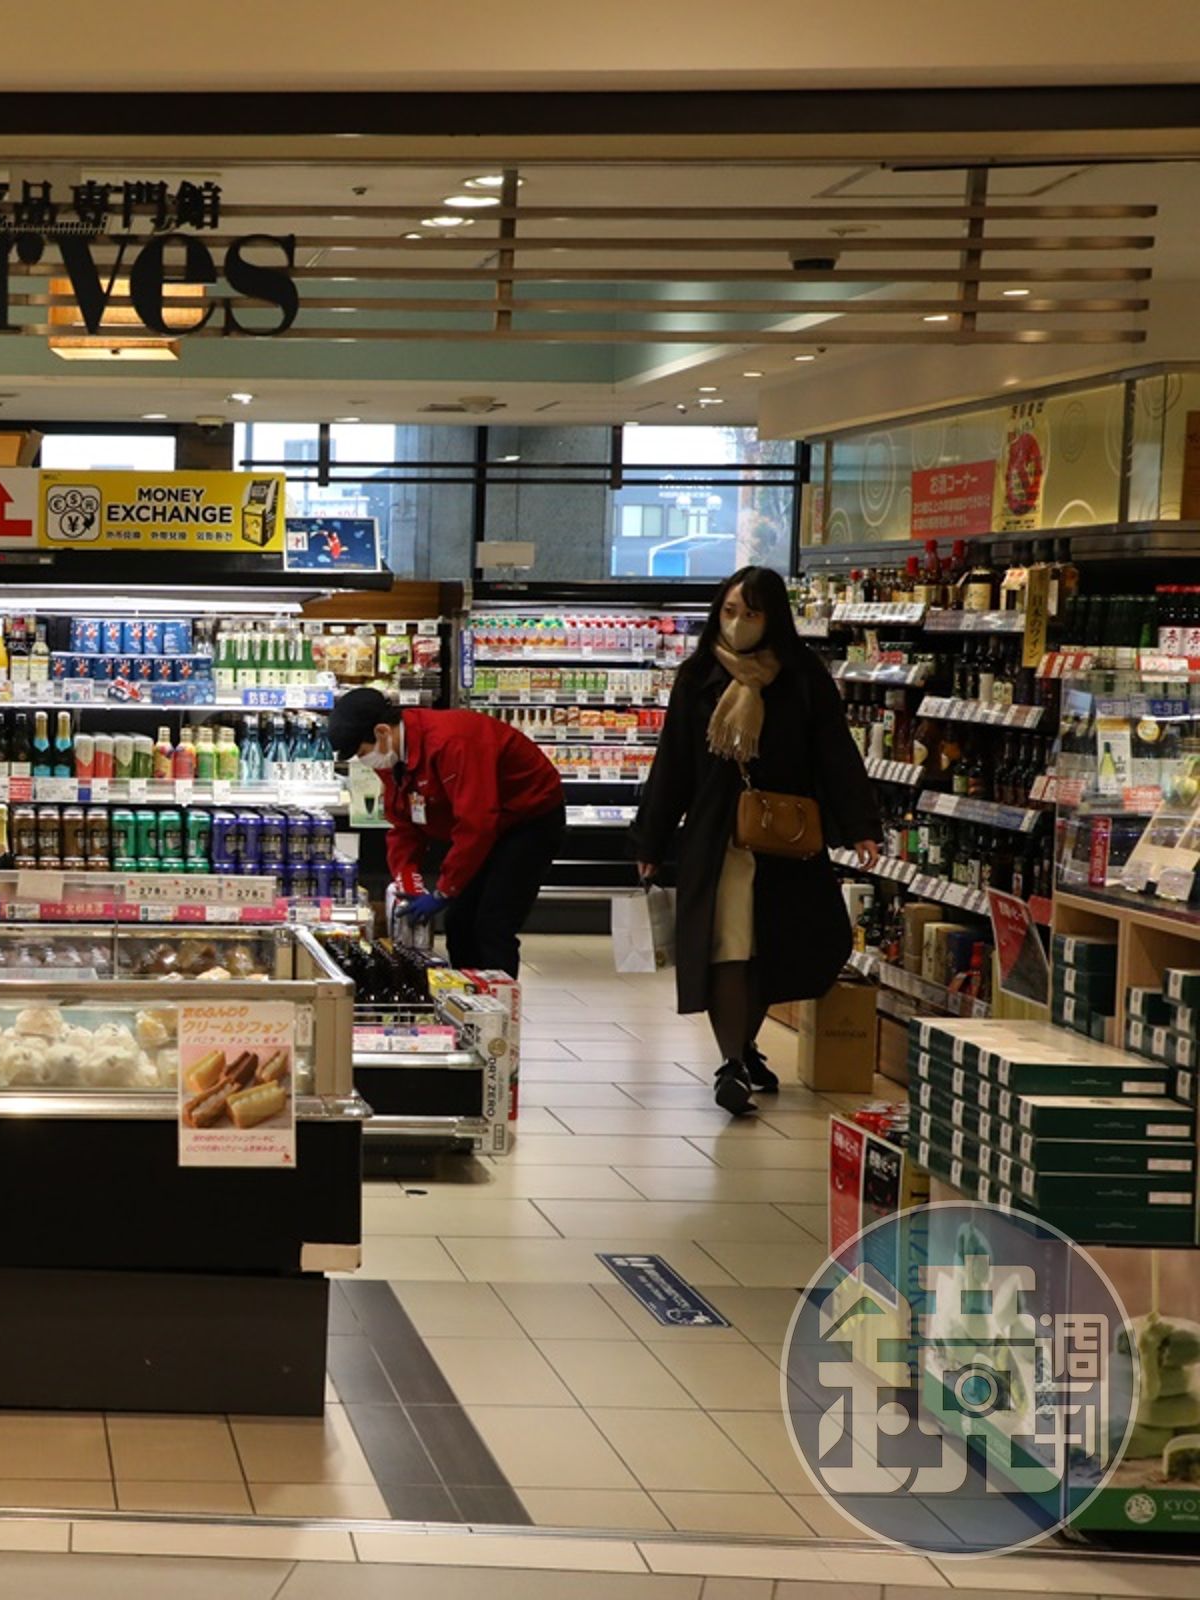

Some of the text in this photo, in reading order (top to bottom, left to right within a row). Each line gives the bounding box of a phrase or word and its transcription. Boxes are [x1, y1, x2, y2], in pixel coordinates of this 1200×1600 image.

[929, 471, 979, 495] お酒コーナー
[138, 487, 204, 503] MONEY
[106, 505, 233, 523] EXCHANGE
[182, 1020, 290, 1034] クリームシフォン
[486, 1057, 497, 1117] DRY ZERO
[1163, 1498, 1200, 1512] KYO
